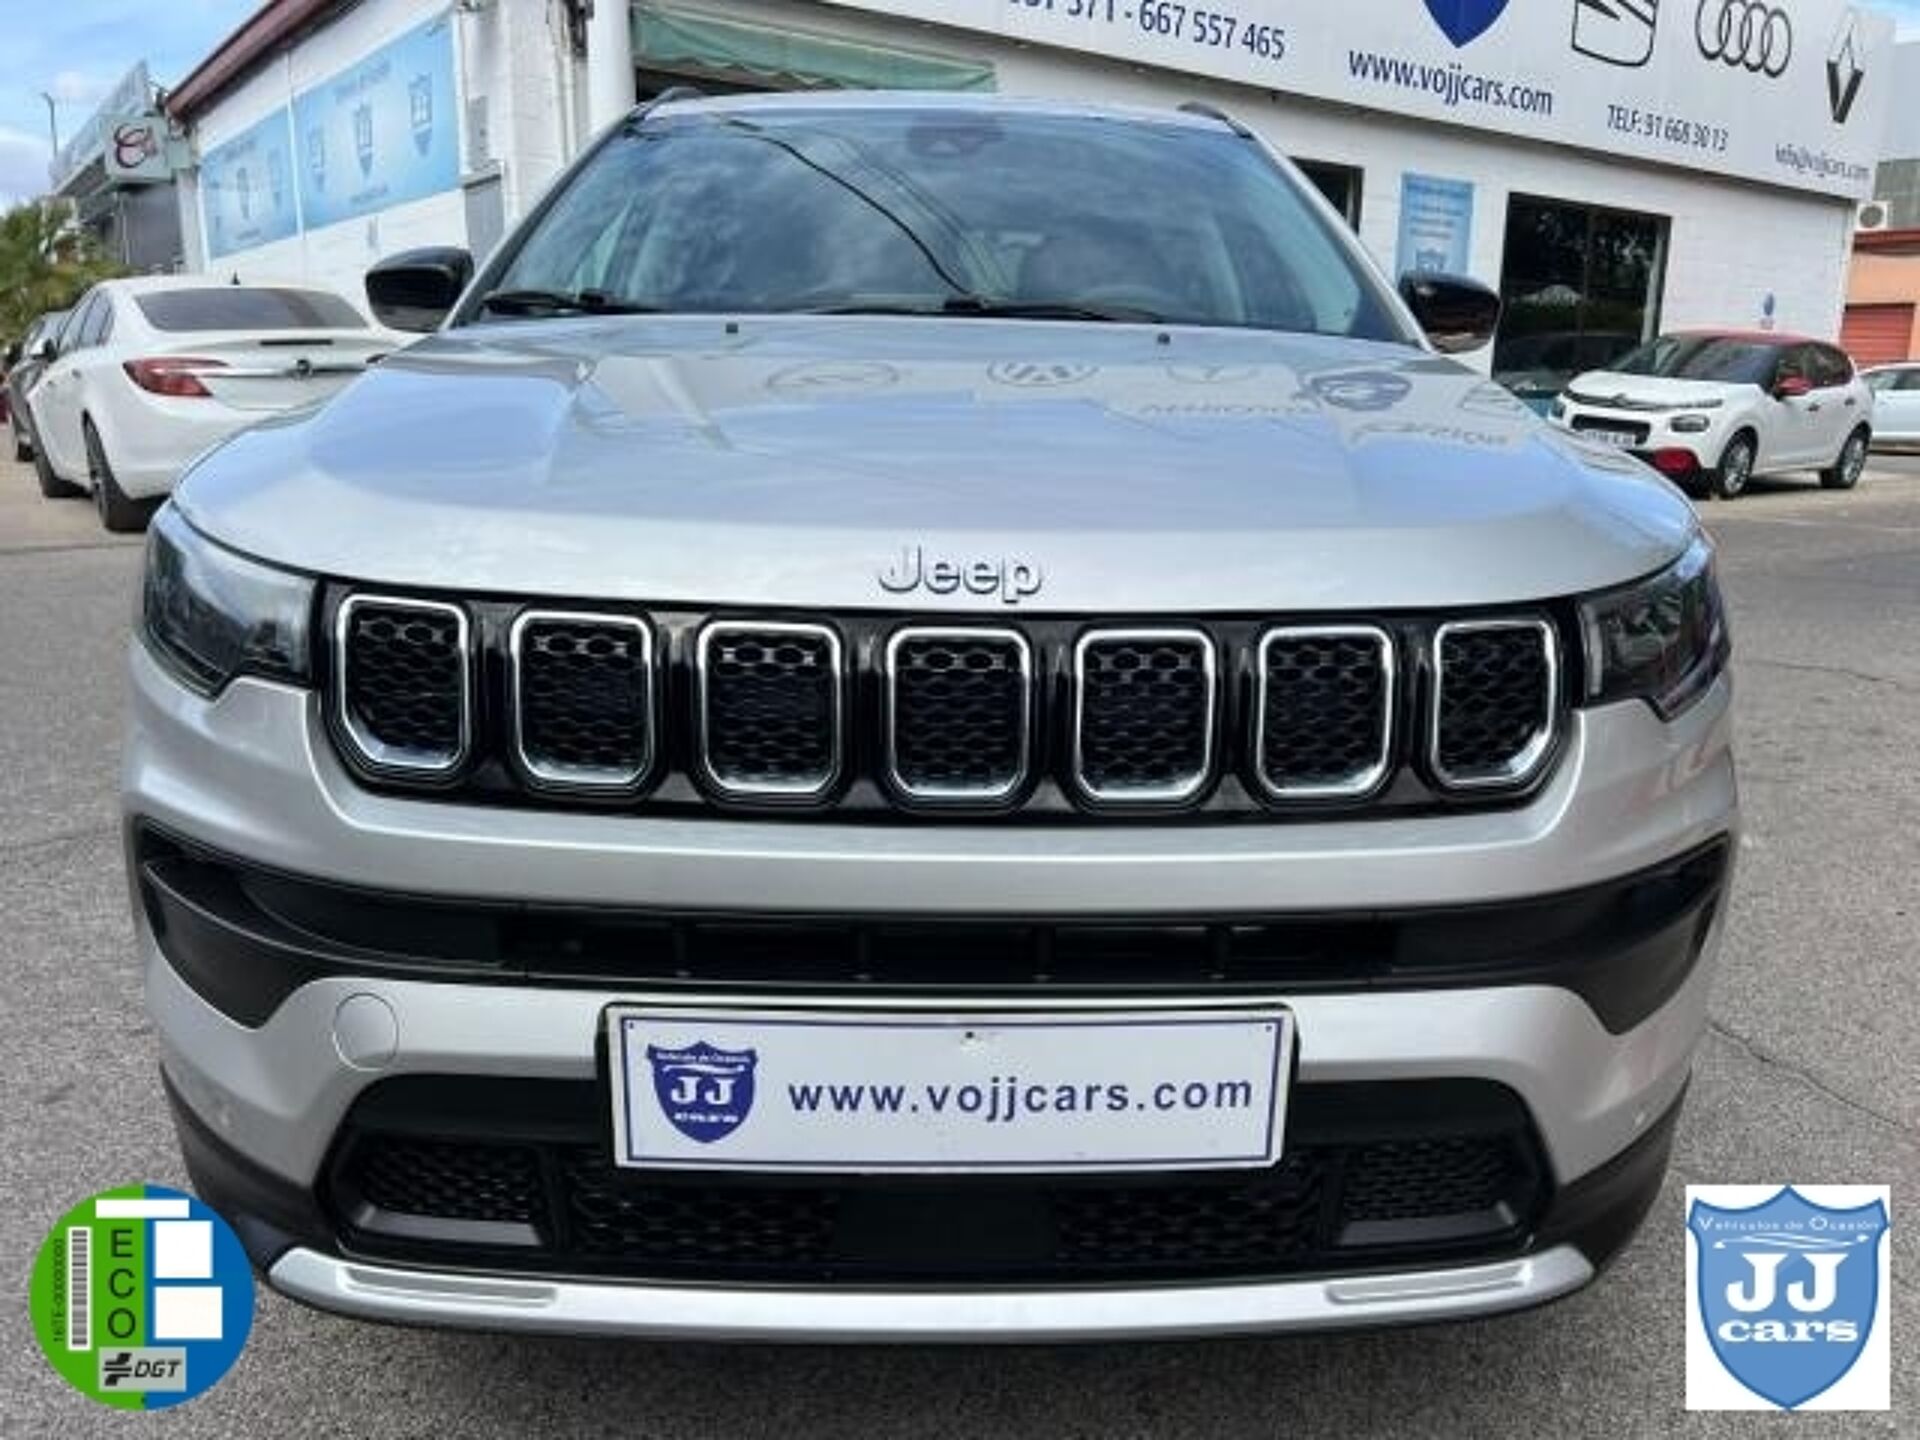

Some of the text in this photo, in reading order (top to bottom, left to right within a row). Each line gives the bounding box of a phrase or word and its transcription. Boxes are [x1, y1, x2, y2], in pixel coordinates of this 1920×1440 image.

[1139, 1, 1186, 38] 667
[1193, 11, 1237, 49] 557
[1242, 23, 1286, 60] 465
[1349, 50, 1553, 115] www.vojjcars.com
[878, 545, 1044, 603] Jeep
[671, 1076, 736, 1105] JJ
[788, 1075, 1253, 1122] www.vojjcars.com
